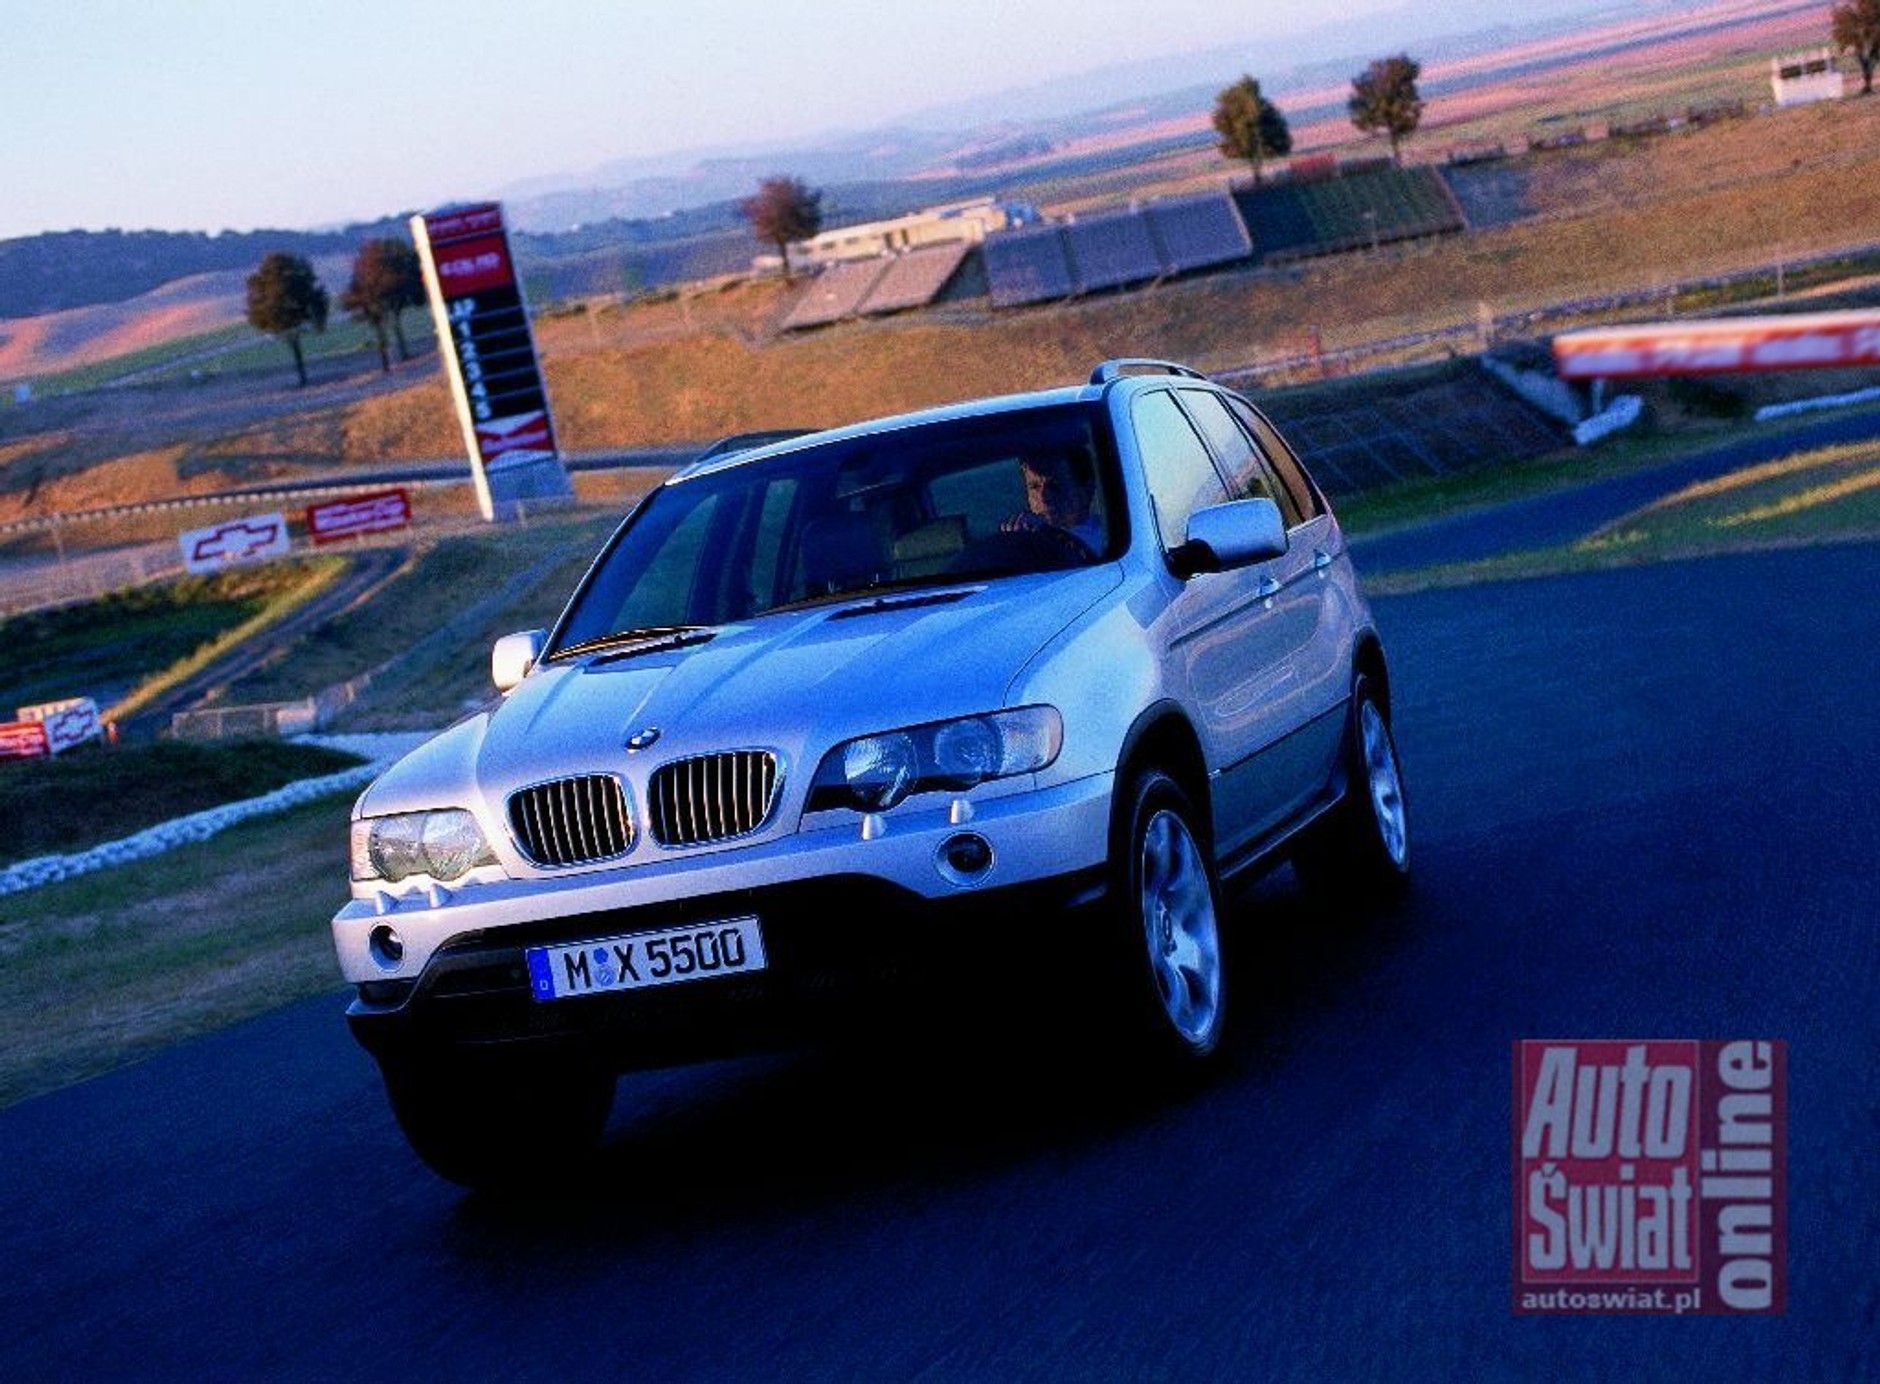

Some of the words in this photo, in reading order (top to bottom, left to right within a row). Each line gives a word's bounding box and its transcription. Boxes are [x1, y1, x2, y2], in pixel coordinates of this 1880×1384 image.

[563, 950, 592, 990] M
[613, 943, 641, 984] X
[645, 928, 746, 978] 5500
